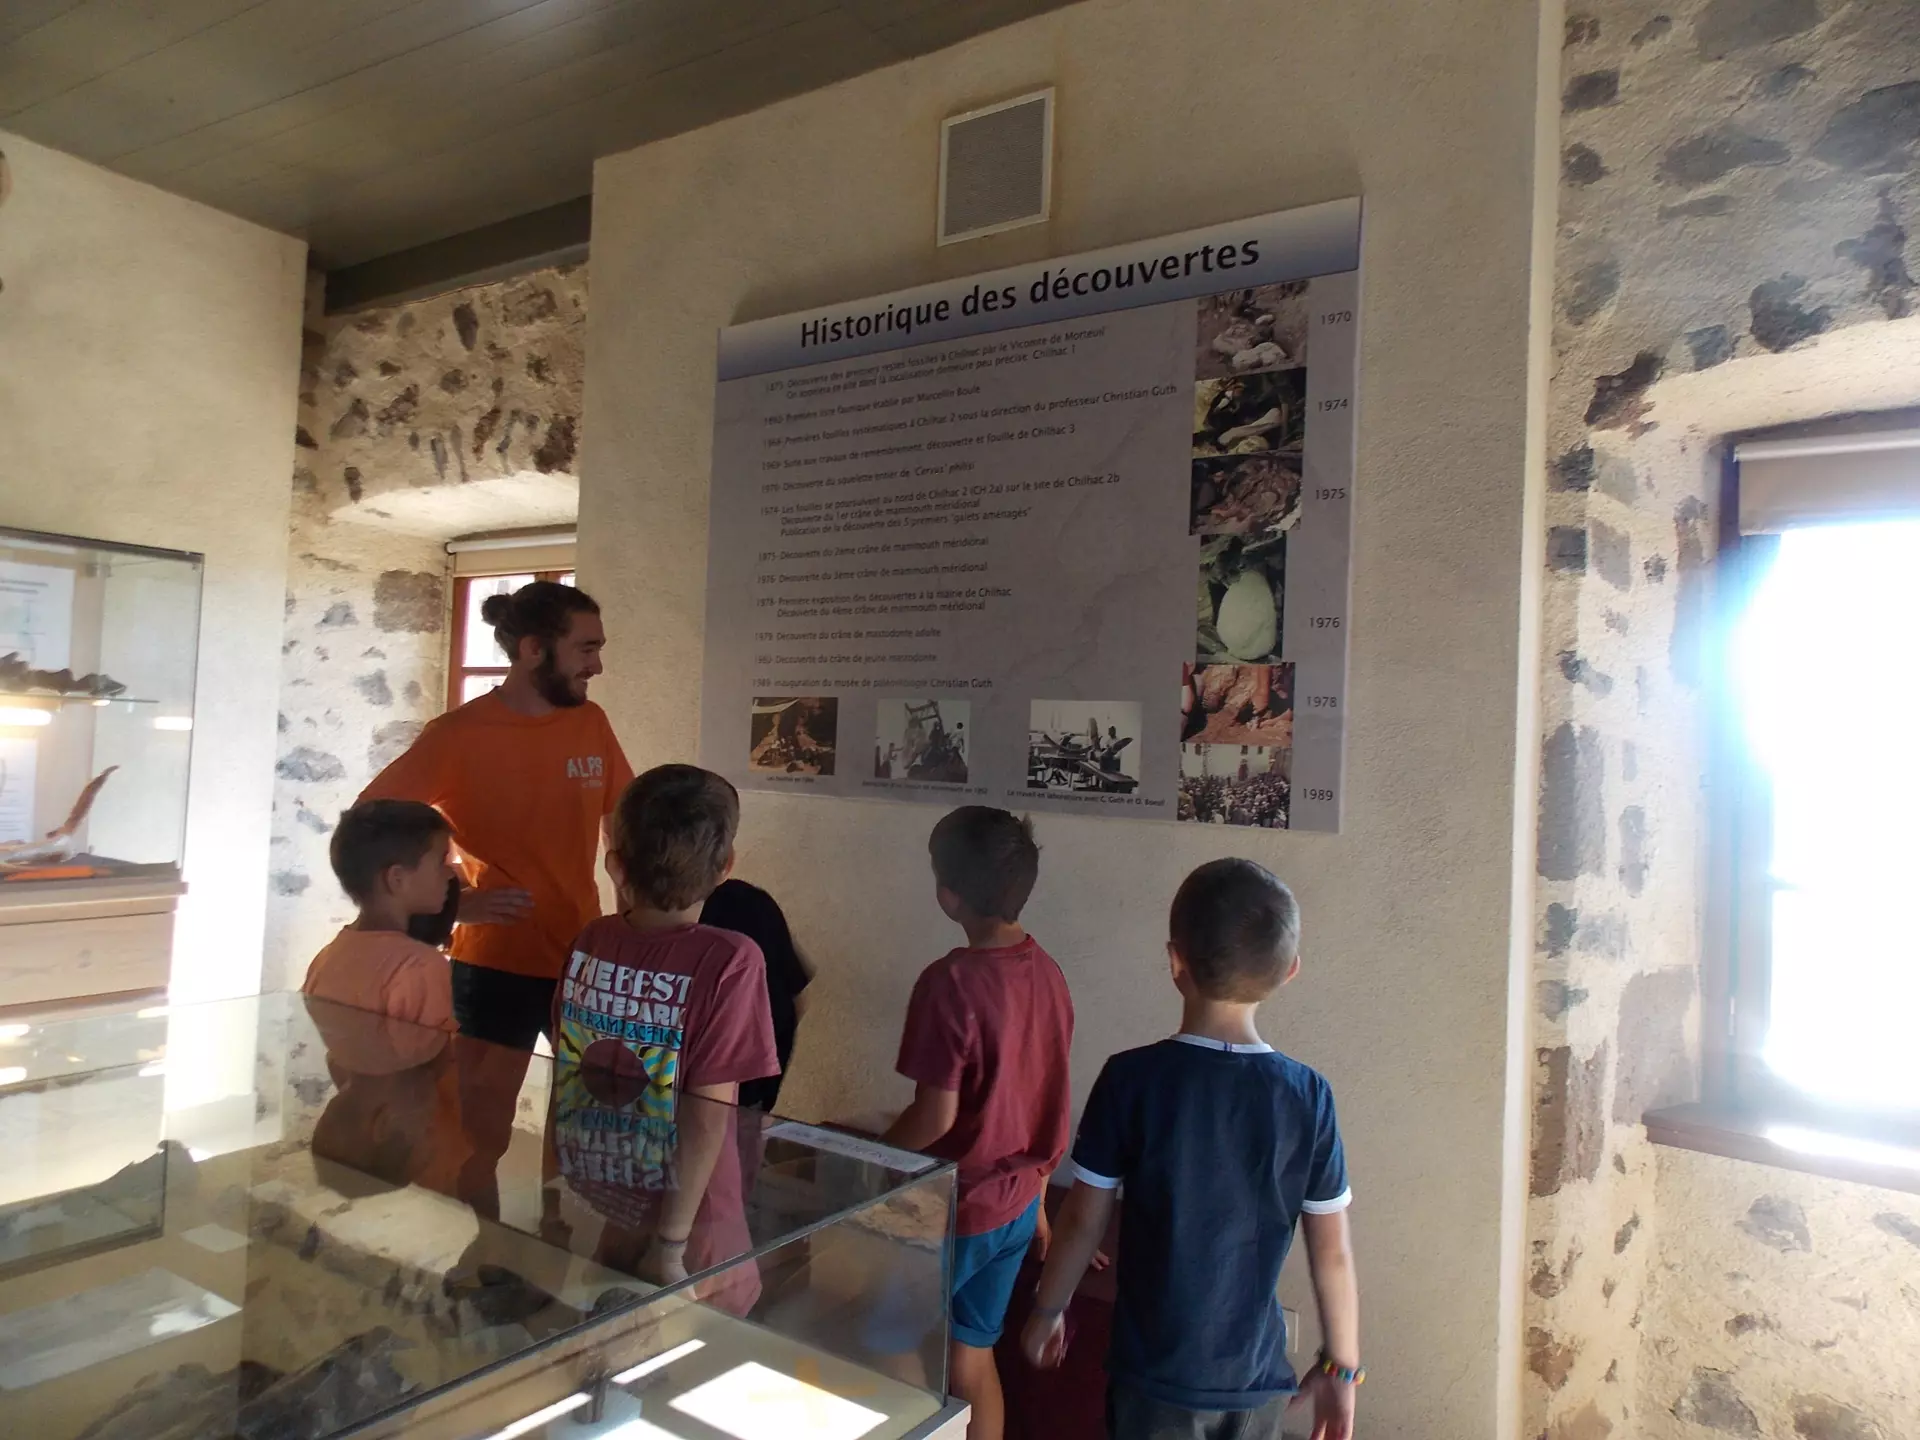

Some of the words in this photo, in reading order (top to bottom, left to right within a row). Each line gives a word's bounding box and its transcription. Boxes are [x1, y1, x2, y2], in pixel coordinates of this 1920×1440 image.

[800, 299, 949, 348] Historique
[961, 285, 1016, 316] des
[1029, 238, 1260, 304] découvertes
[1320, 310, 1352, 325] 1970
[956, 385, 980, 395] Boule
[957, 412, 978, 420] sous
[990, 404, 1031, 416] direction
[1048, 396, 1099, 411] professeur
[1102, 389, 1149, 402] Christian
[1150, 384, 1177, 396] Guth
[1317, 398, 1349, 412] 1974
[1106, 473, 1120, 482] 2b
[1315, 487, 1346, 500] 1975
[1309, 616, 1341, 628] 1976
[929, 679, 969, 687] Christian
[970, 679, 993, 687] Guth
[1306, 695, 1338, 708] 1978
[1303, 788, 1334, 801] 1989
[568, 950, 616, 992] THE
[614, 964, 695, 1005] BEST
[562, 977, 688, 1030] SKATEPARK
